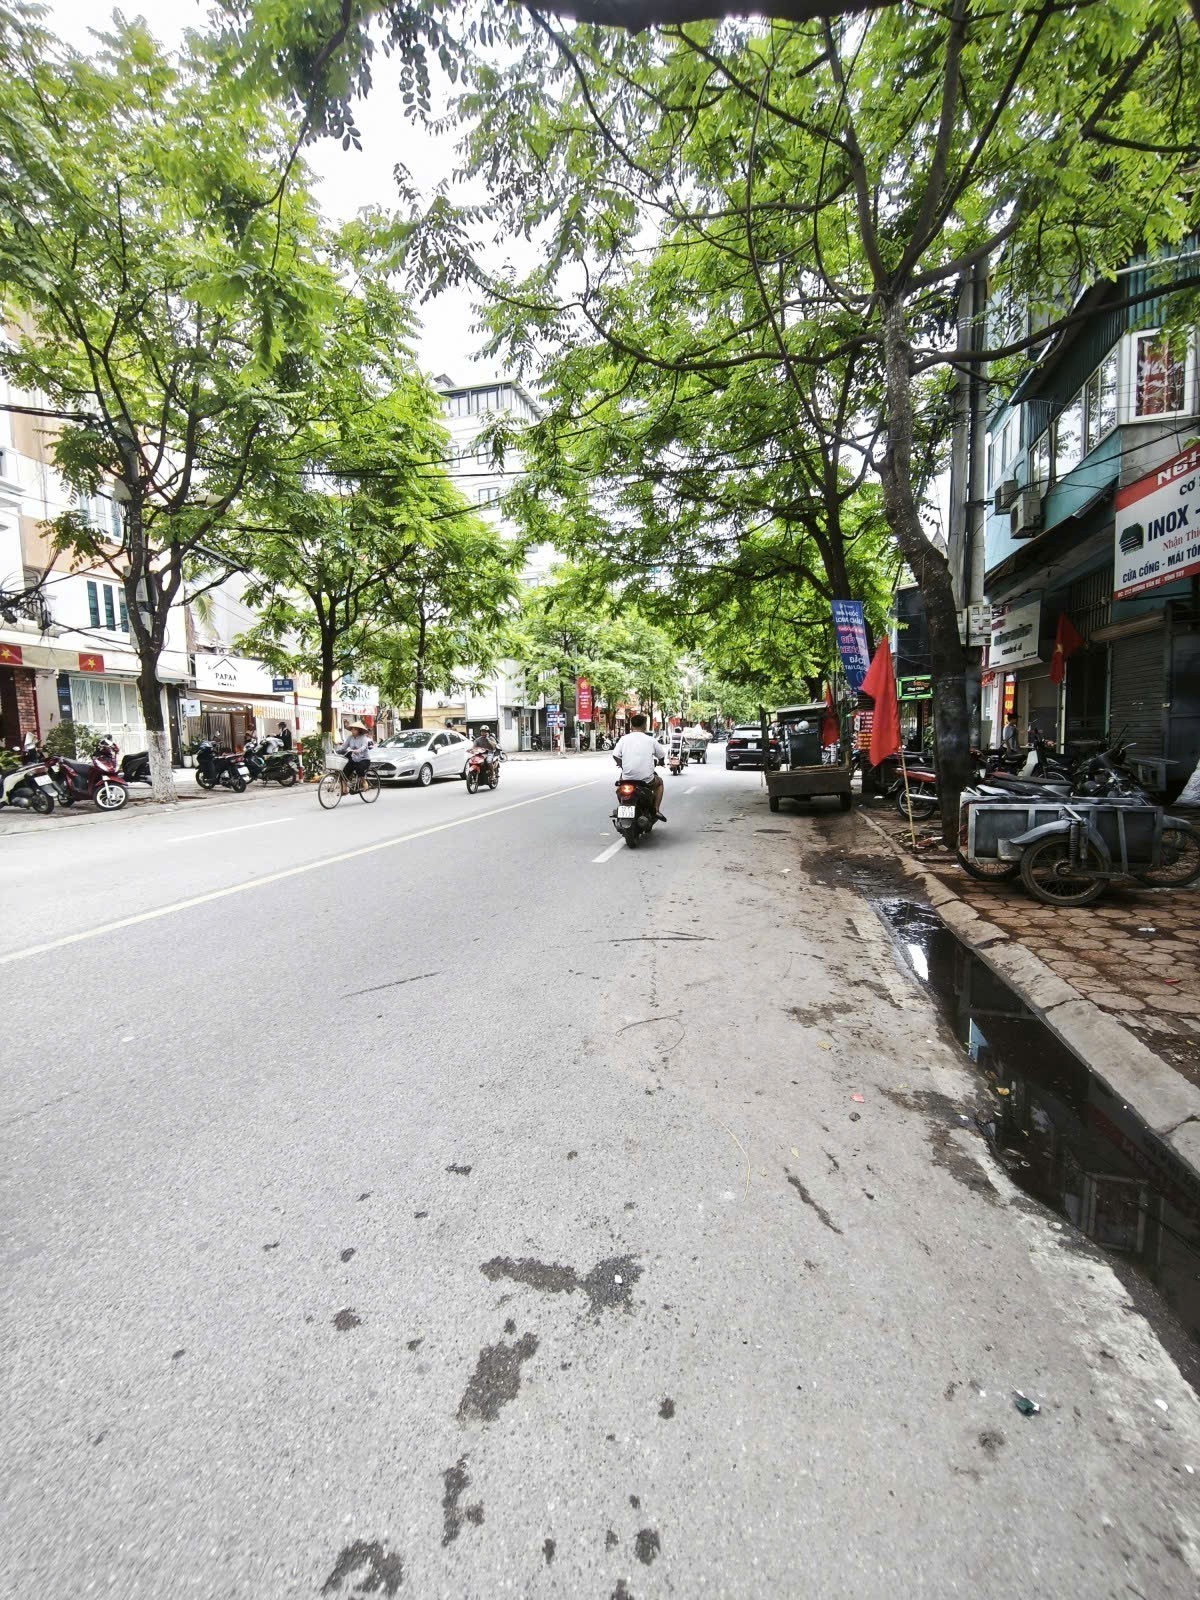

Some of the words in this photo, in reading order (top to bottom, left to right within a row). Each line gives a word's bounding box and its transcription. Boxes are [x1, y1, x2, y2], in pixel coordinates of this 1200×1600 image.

[1147, 503, 1189, 542] INOX
[1163, 536, 1183, 551] Nhận
[1186, 527, 1200, 541] Thi
[1122, 568, 1137, 583] CỬA
[1138, 560, 1160, 577] CỐNG
[1167, 550, 1184, 567] MÁI
